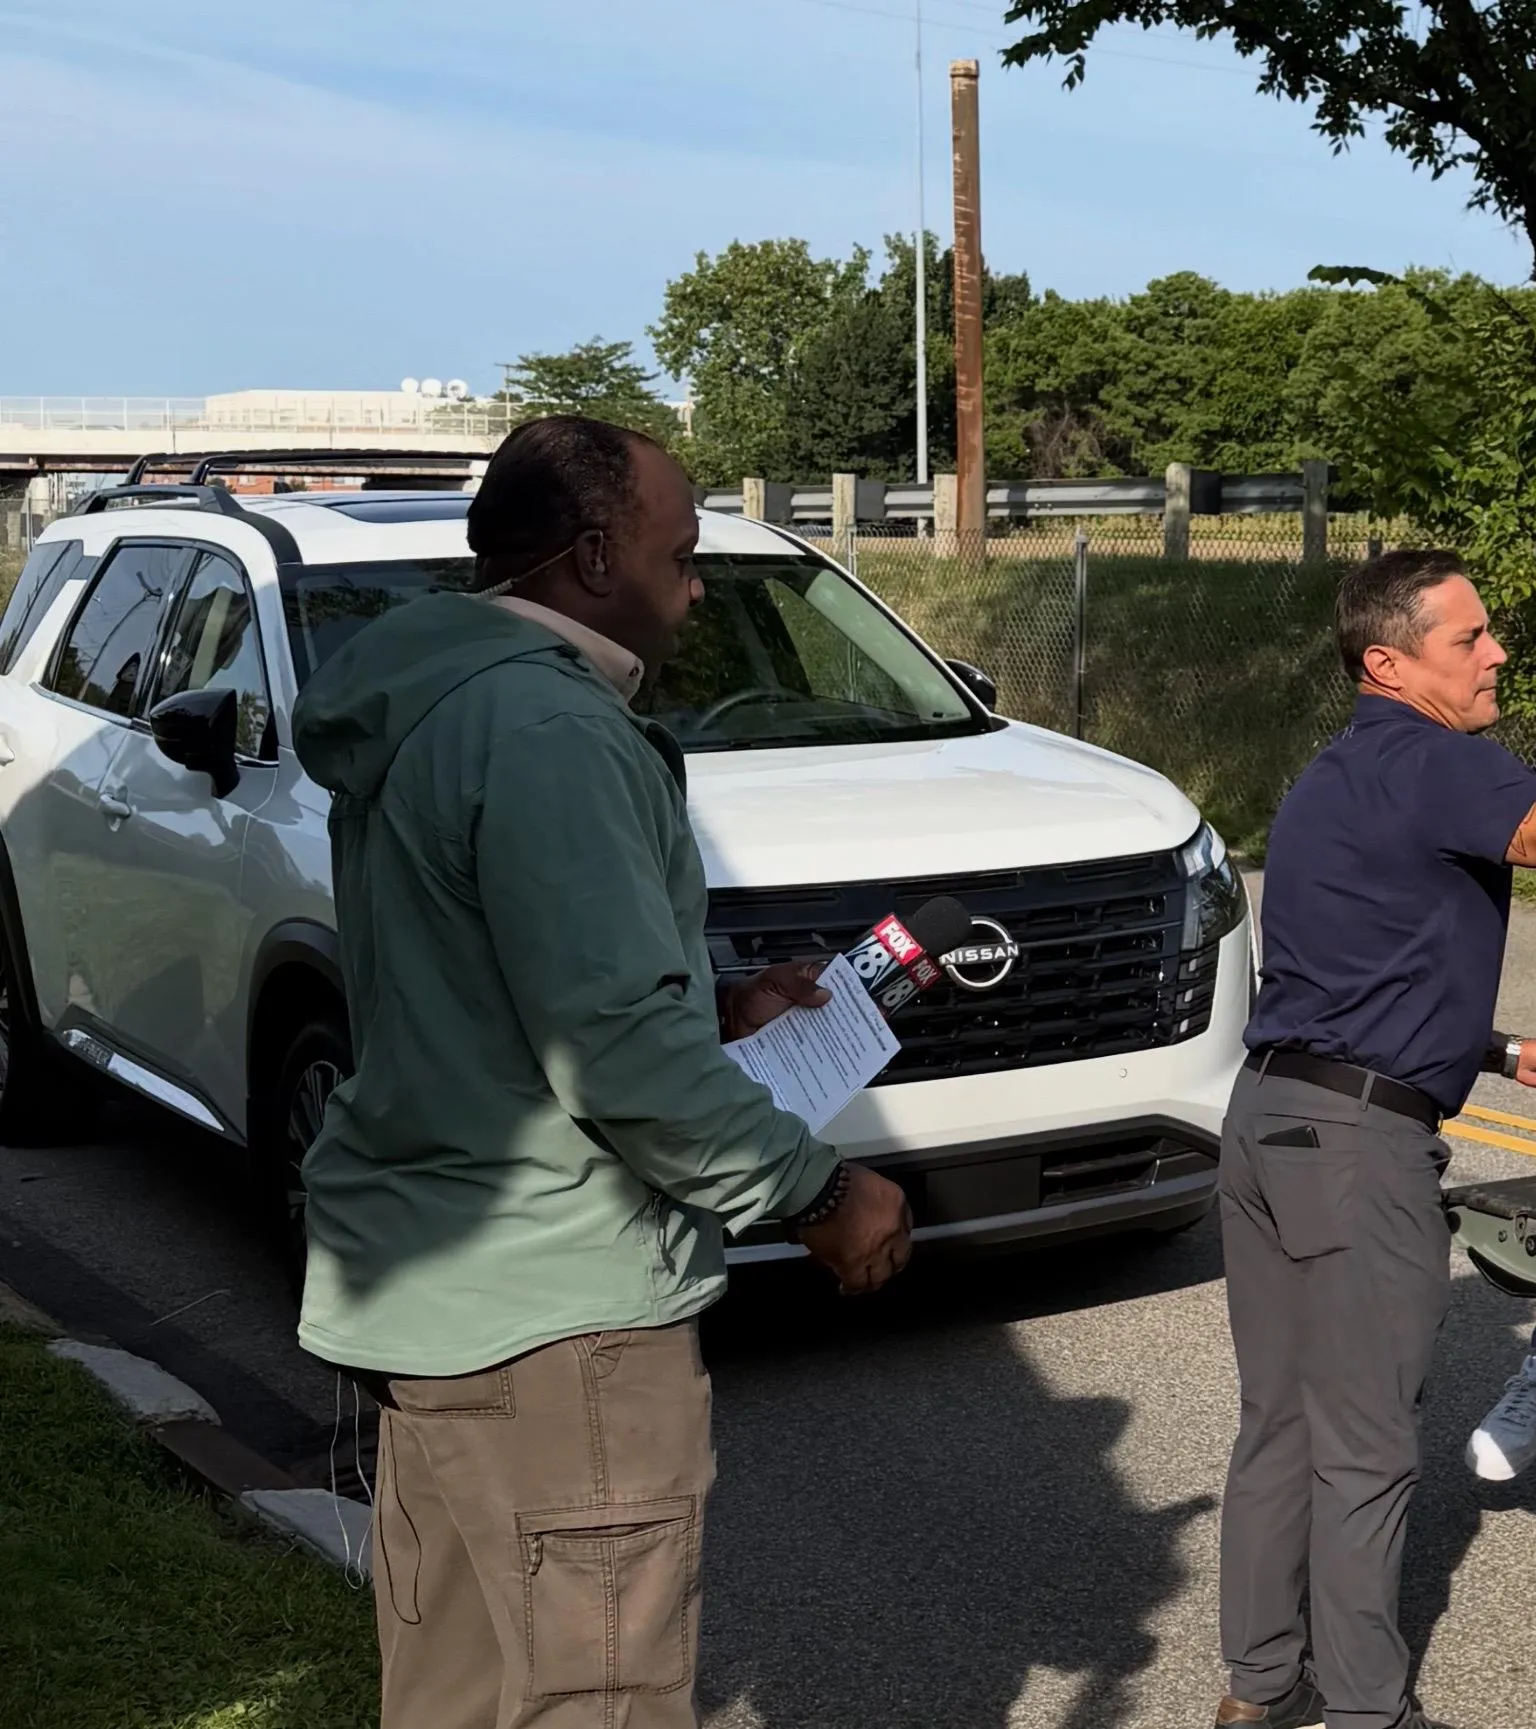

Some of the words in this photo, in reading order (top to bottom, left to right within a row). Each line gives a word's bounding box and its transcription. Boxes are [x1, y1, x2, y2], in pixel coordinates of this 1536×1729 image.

[879, 920, 917, 960] FOX
[941, 944, 1018, 965] NISSAN
[853, 946, 886, 979] 8
[912, 958, 938, 985] FOX
[881, 978, 914, 1007] 8
